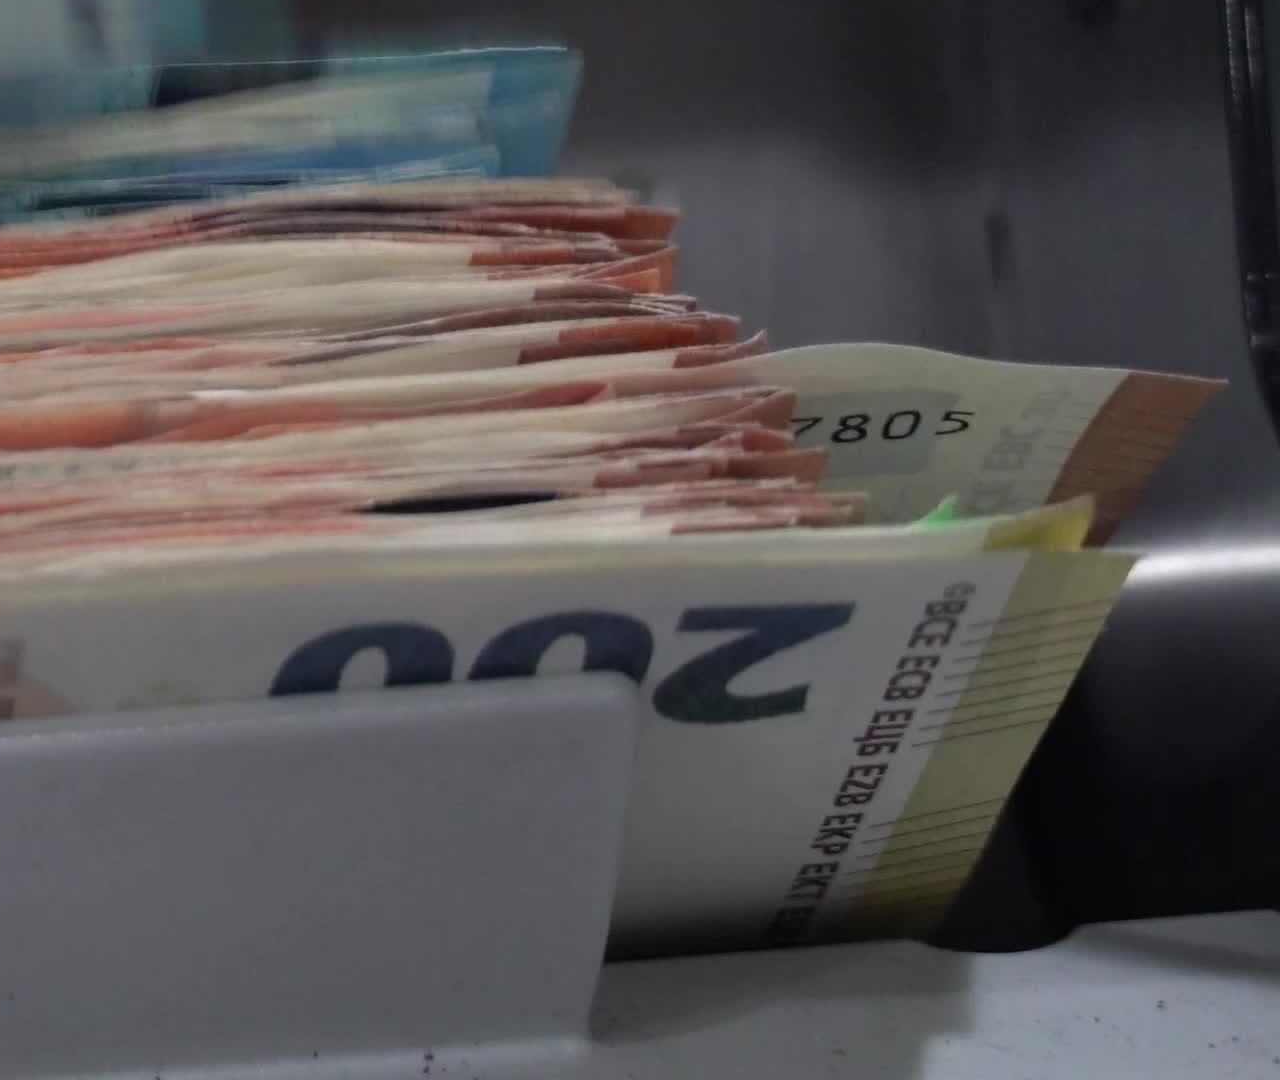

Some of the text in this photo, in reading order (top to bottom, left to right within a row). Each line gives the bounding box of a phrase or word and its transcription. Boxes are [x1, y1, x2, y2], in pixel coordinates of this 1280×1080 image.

[787, 408, 976, 445] 7805
[883, 655, 941, 702] ECB
[833, 763, 889, 807] EZB
[810, 812, 865, 855] EKP
